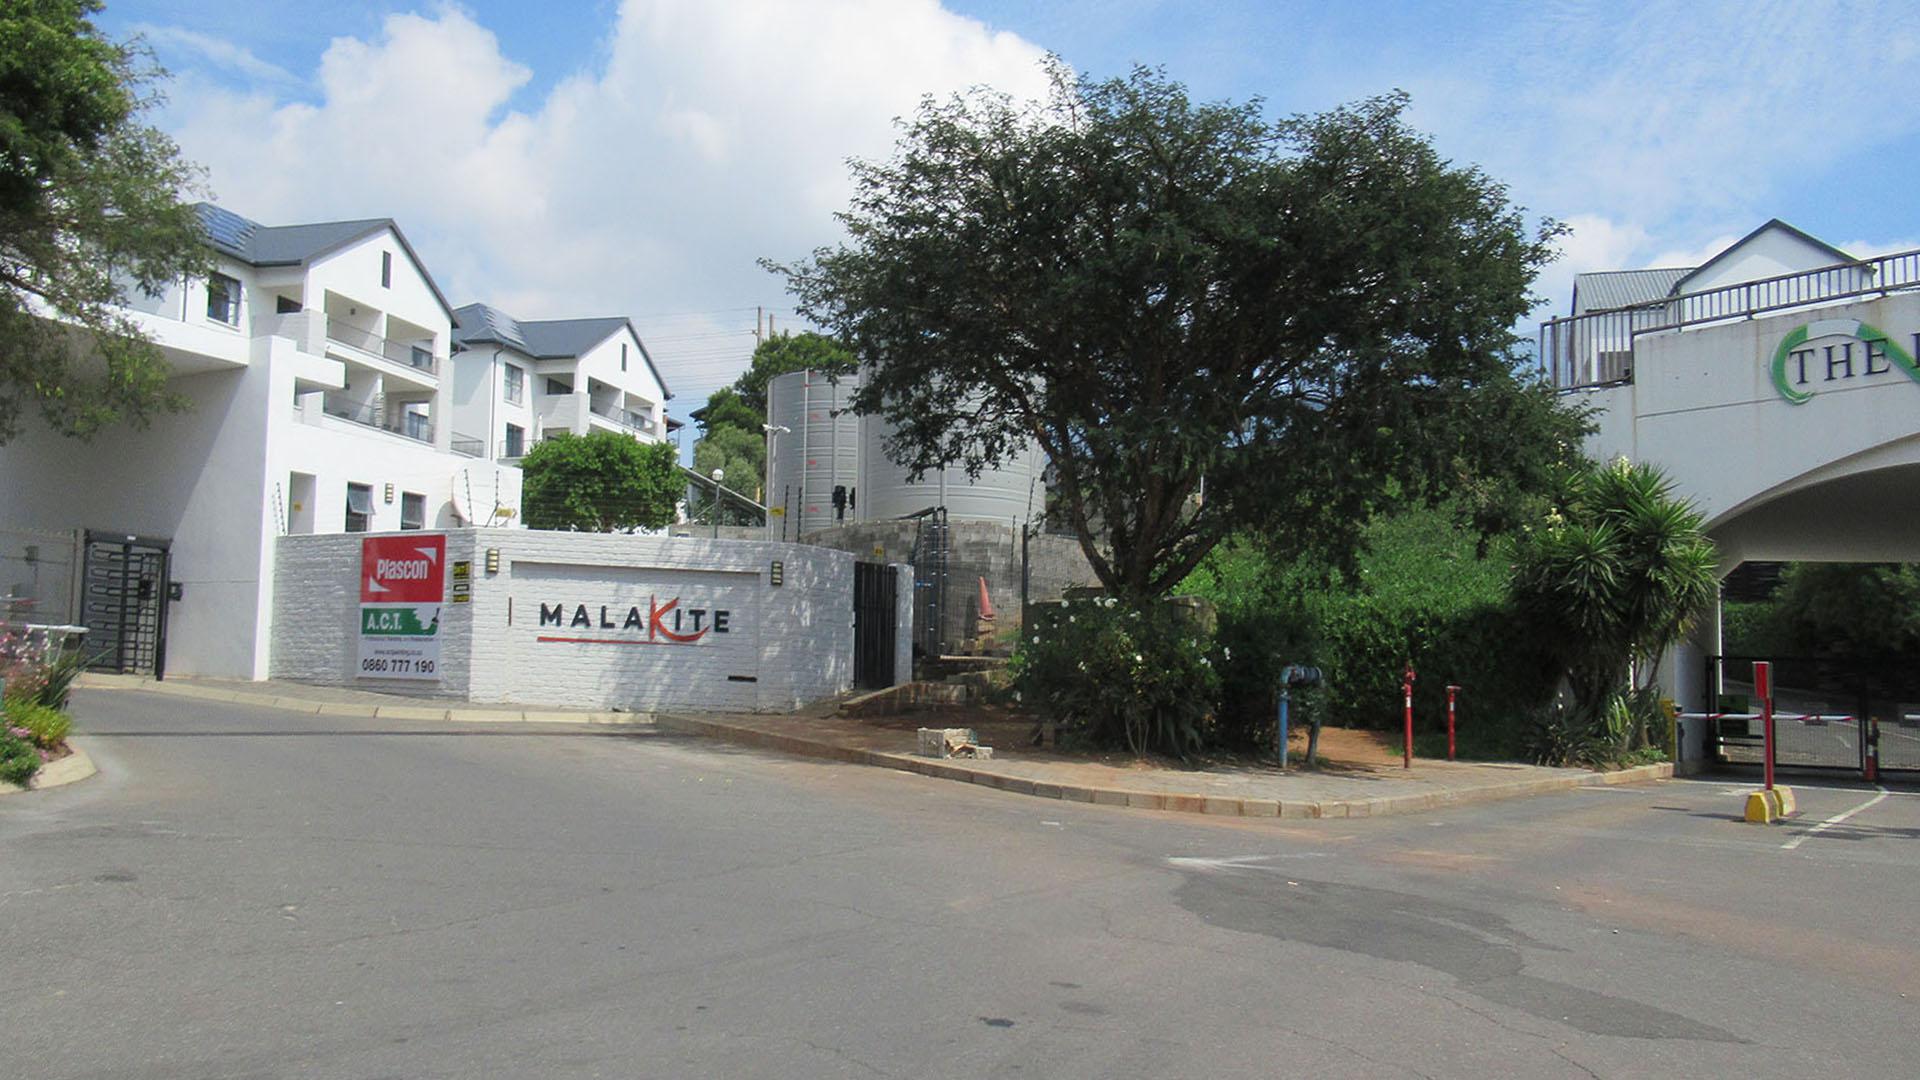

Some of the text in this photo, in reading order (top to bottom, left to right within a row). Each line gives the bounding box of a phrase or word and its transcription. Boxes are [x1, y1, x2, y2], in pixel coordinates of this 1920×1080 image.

[1789, 338, 1891, 384] THE
[377, 559, 428, 580] Plascon
[540, 594, 730, 641] MALAKITE
[362, 658, 434, 673] 0860 777 190
